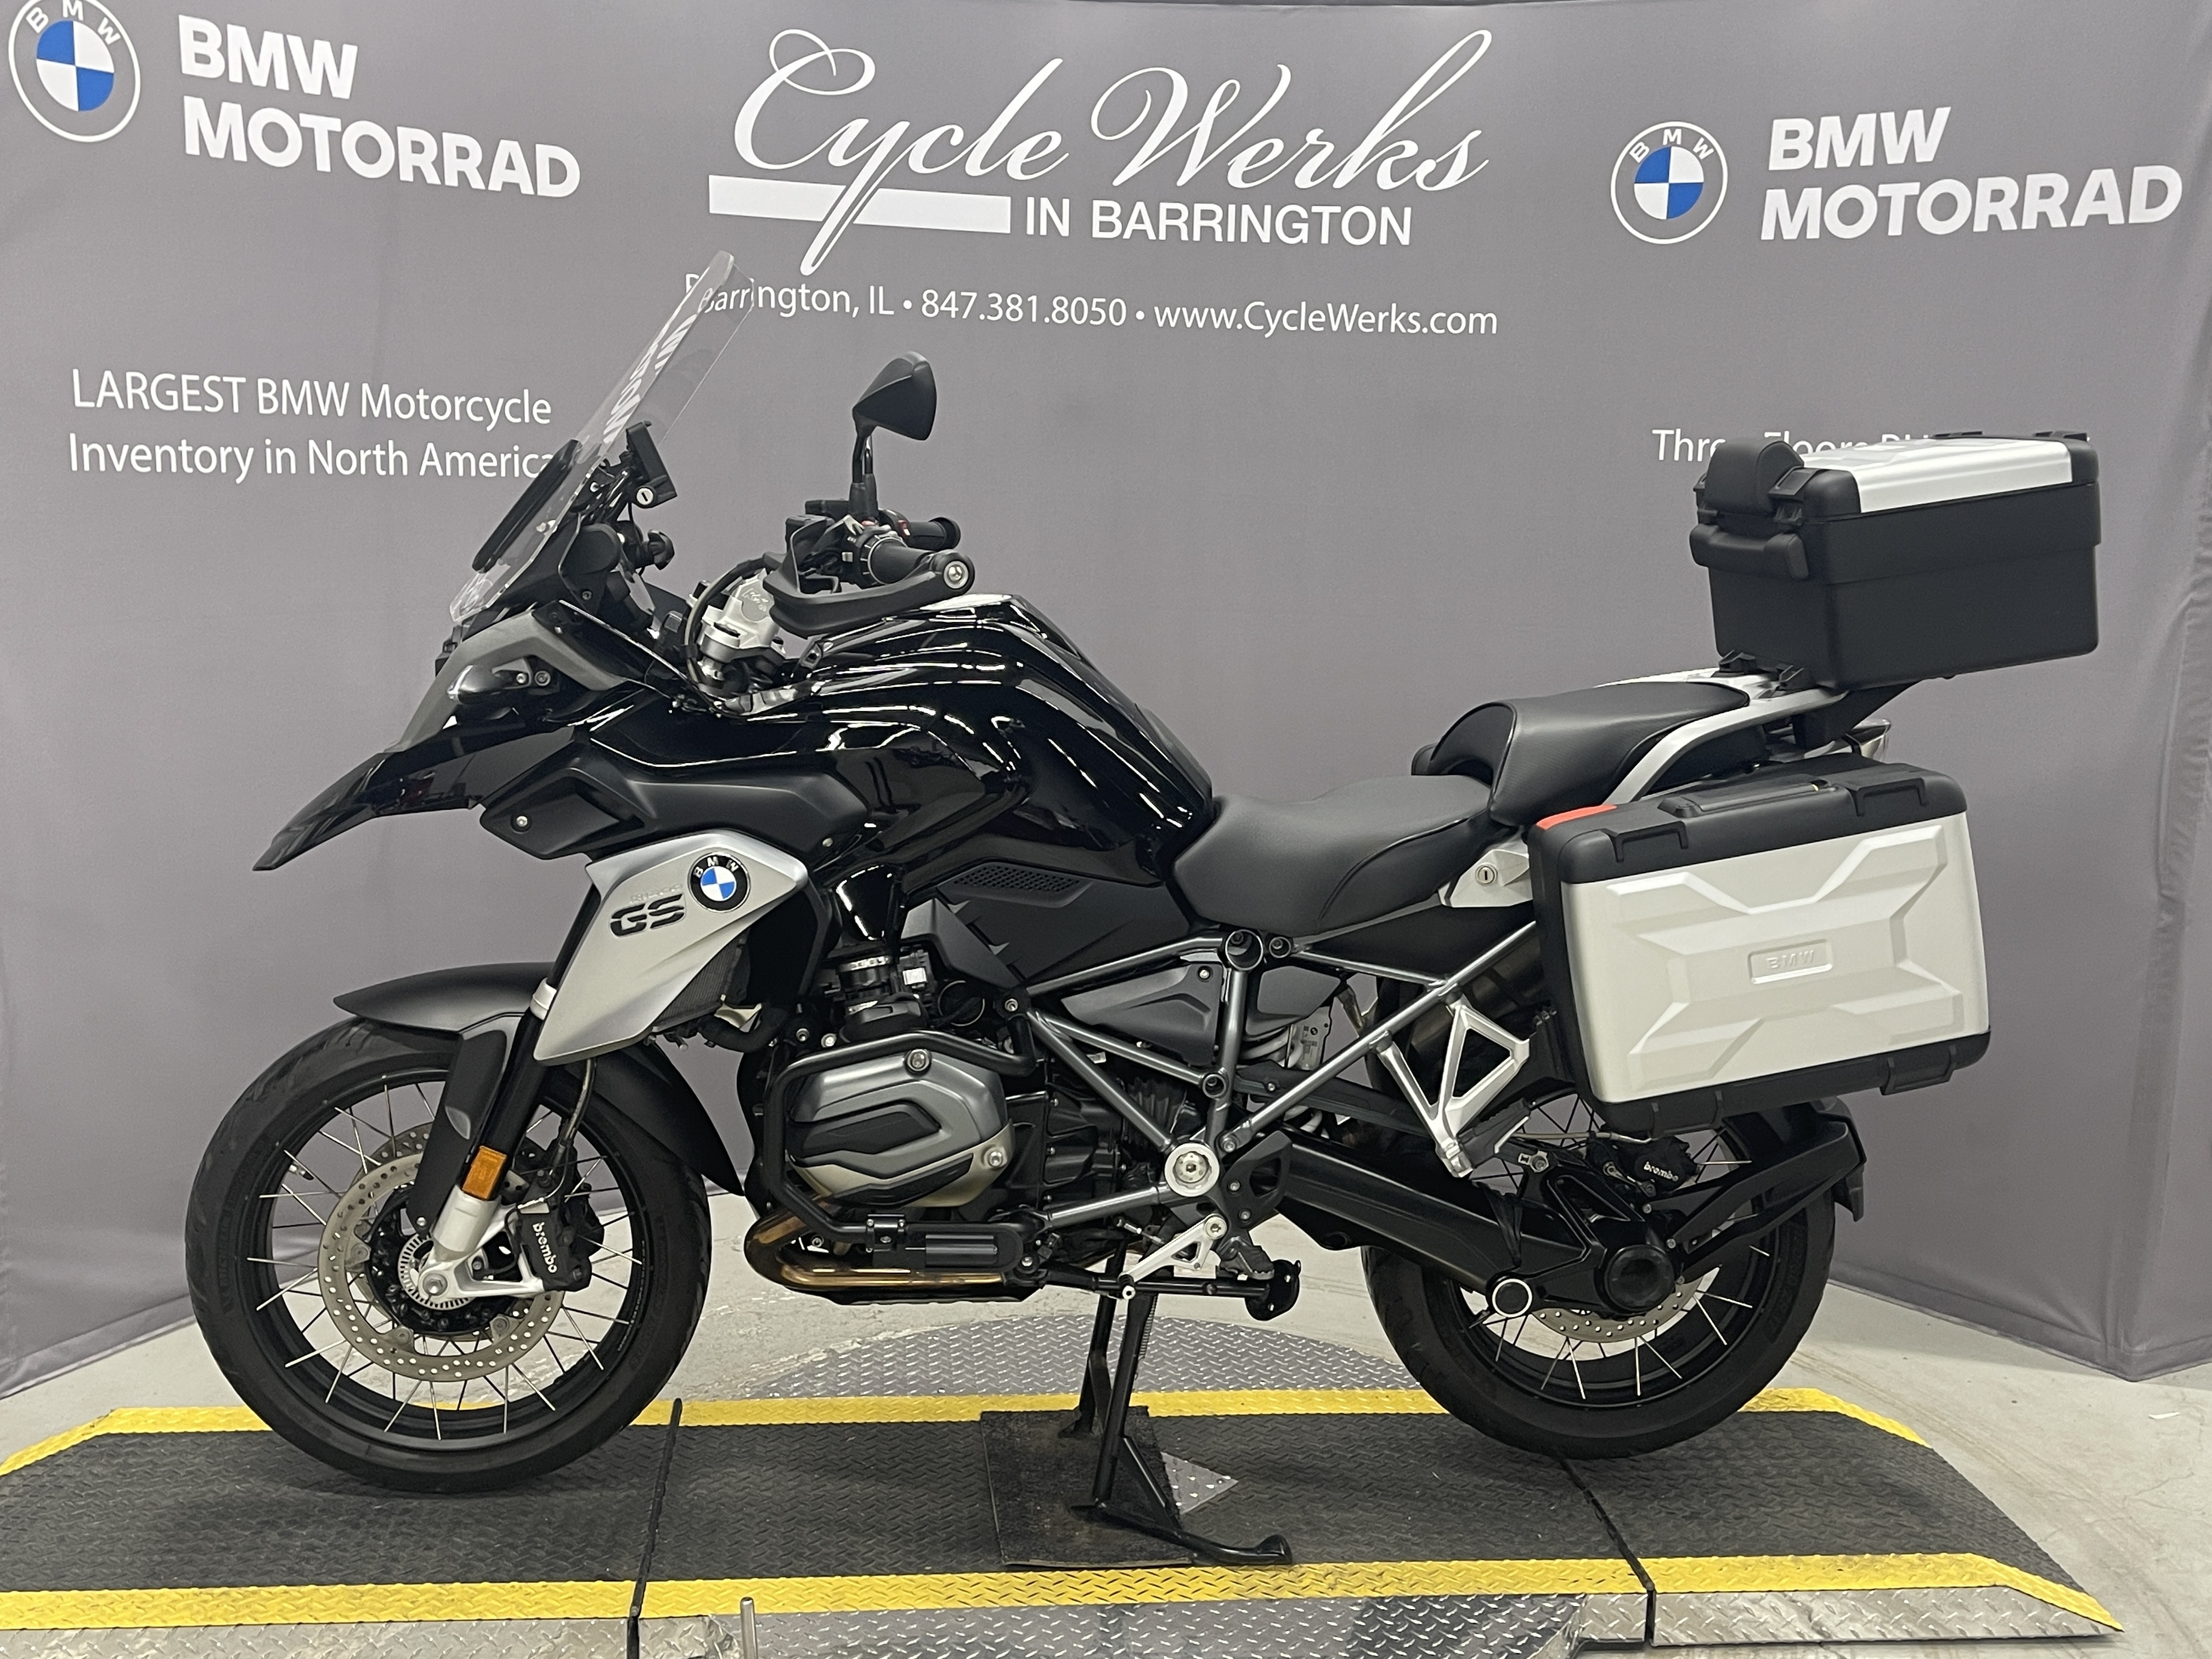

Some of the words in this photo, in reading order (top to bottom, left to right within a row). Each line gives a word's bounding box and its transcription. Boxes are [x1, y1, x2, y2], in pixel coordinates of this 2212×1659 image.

[26, 0, 121, 45] BMW
[179, 15, 358, 99] BMW
[184, 96, 580, 198] MOTORRAD
[734, 29, 1069, 276] Cycle
[1091, 30, 1492, 191] Werks
[1629, 128, 1714, 163] BMW
[1769, 107, 1951, 171] BMW
[1026, 196, 1070, 236] IN
[1092, 200, 1412, 245] BARRINGTON
[1760, 166, 2182, 240] MOTORRAD
[870, 285, 894, 315] IL
[922, 289, 1126, 326] 847.381.8050
[1154, 301, 1497, 338] www.CycleWerks.com
[72, 369, 246, 413] LARGEST
[257, 378, 349, 416] BMW
[362, 383, 551, 432] Motorcycle
[70, 433, 254, 484] Inventory
[265, 438, 296, 474] in
[308, 439, 408, 476] North
[1652, 428, 1726, 462] Thr
[693, 856, 739, 878] BMW
[610, 893, 685, 936] GS
[1766, 950, 1815, 969] BMW
[1643, 1161, 1679, 1182] brembo
[532, 1222, 557, 1273] brembo
